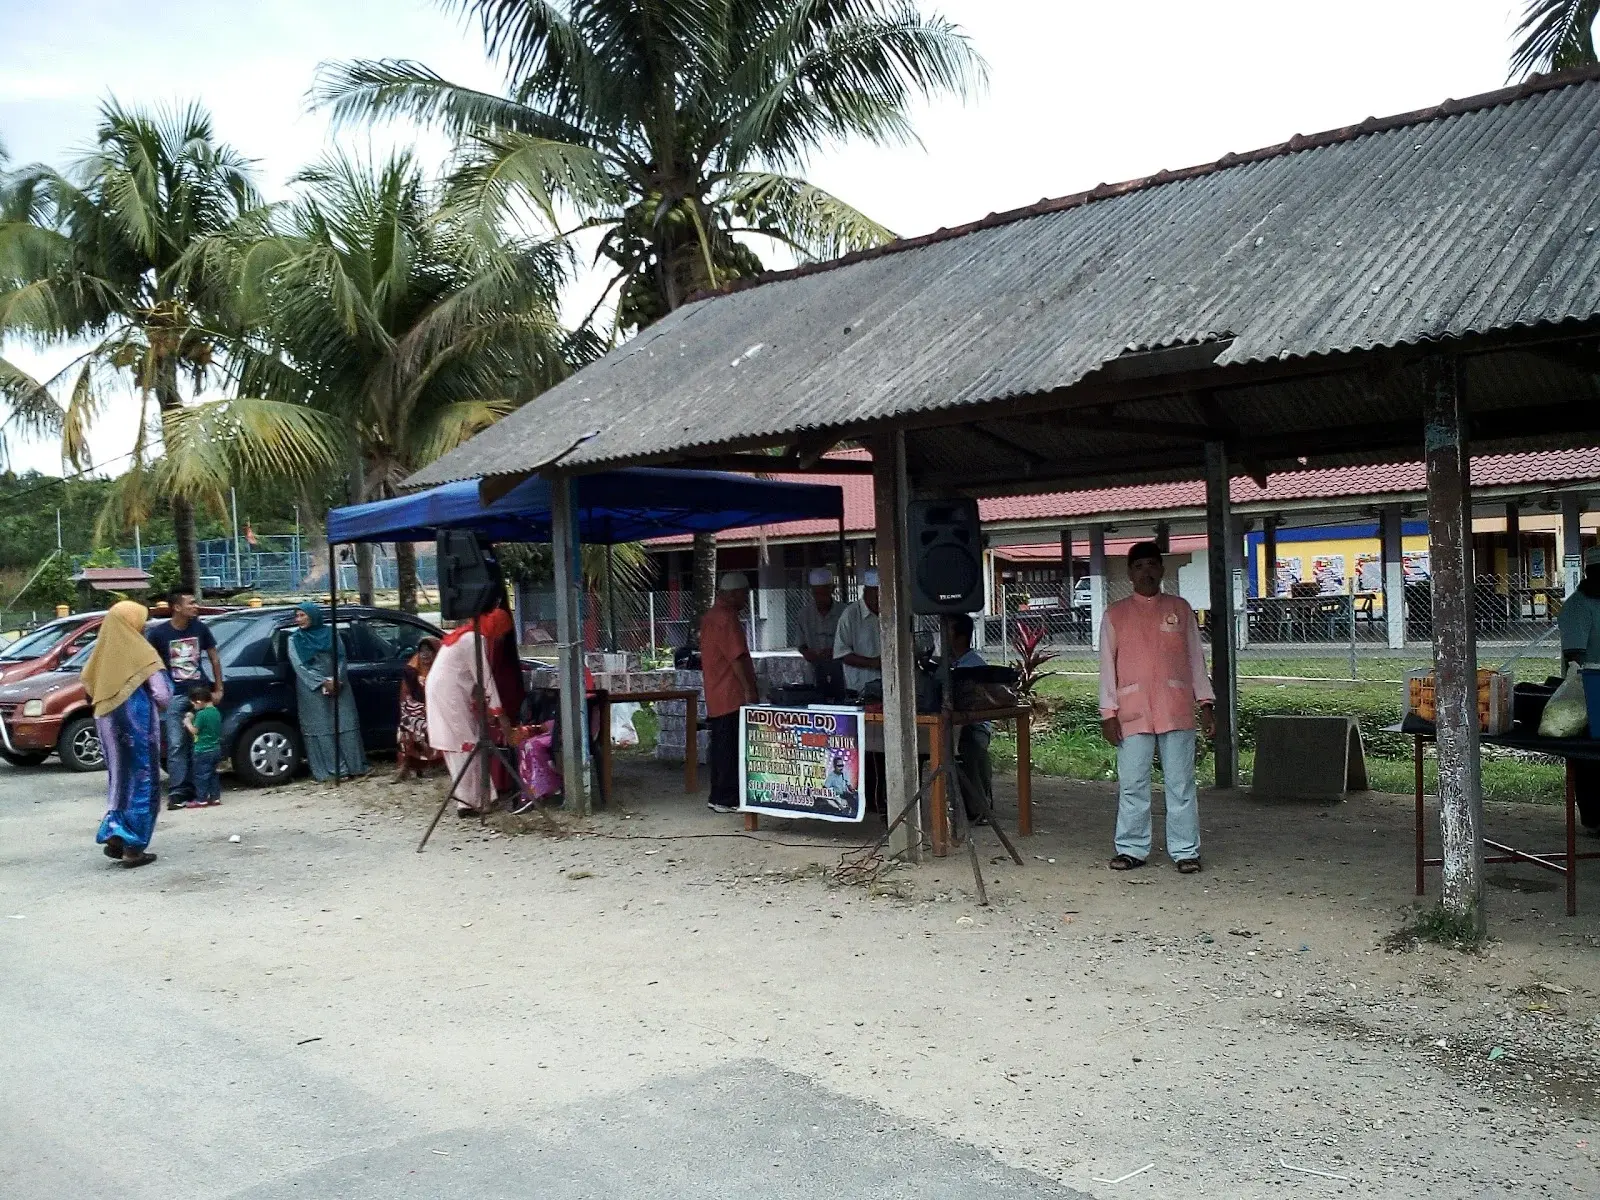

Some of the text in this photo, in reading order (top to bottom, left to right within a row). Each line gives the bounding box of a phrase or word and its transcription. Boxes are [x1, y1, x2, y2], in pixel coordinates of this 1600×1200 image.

[747, 711, 837, 731] MDJ (MAIL DJ)
